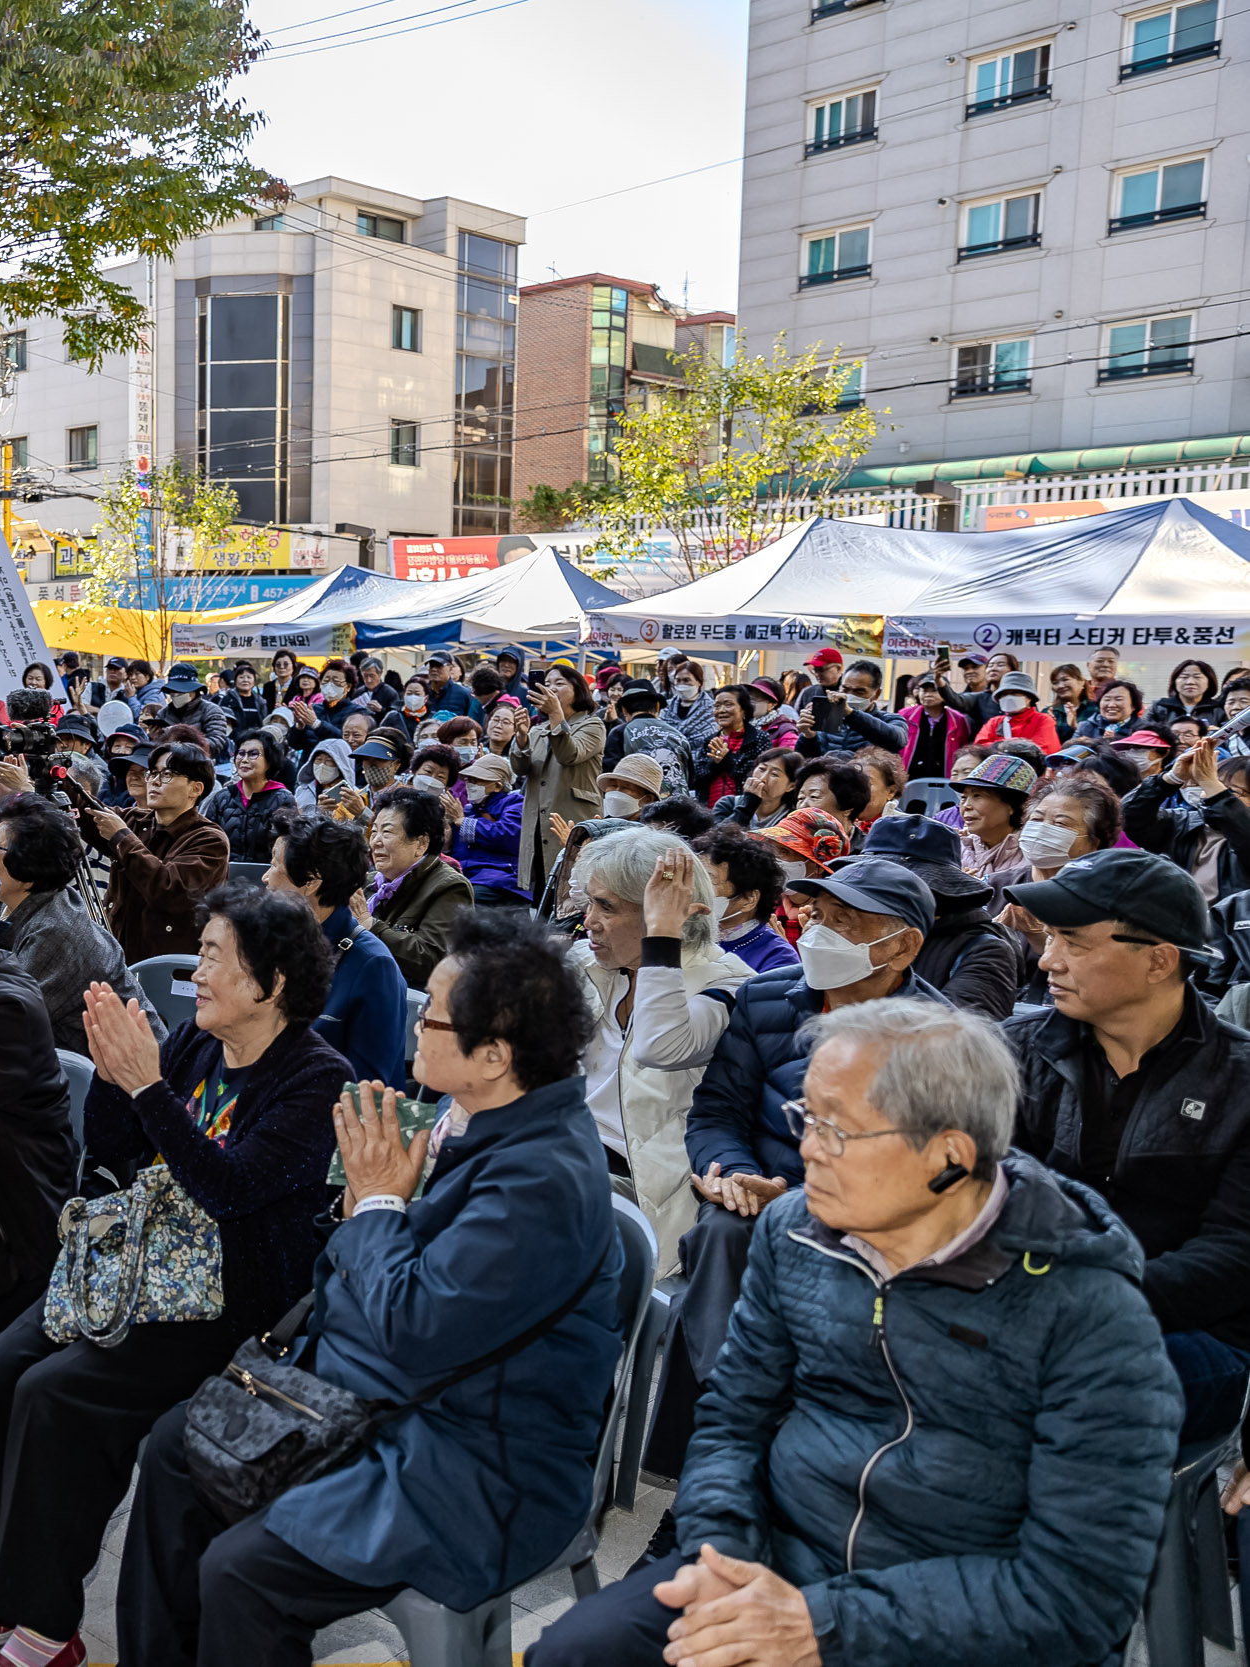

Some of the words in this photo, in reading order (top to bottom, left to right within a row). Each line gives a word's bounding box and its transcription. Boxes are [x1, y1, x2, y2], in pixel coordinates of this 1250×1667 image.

[1006, 629, 1061, 646] 캐릭터
[1067, 628, 1125, 646] 스티커
[1132, 627, 1235, 645] 타투&풍선
